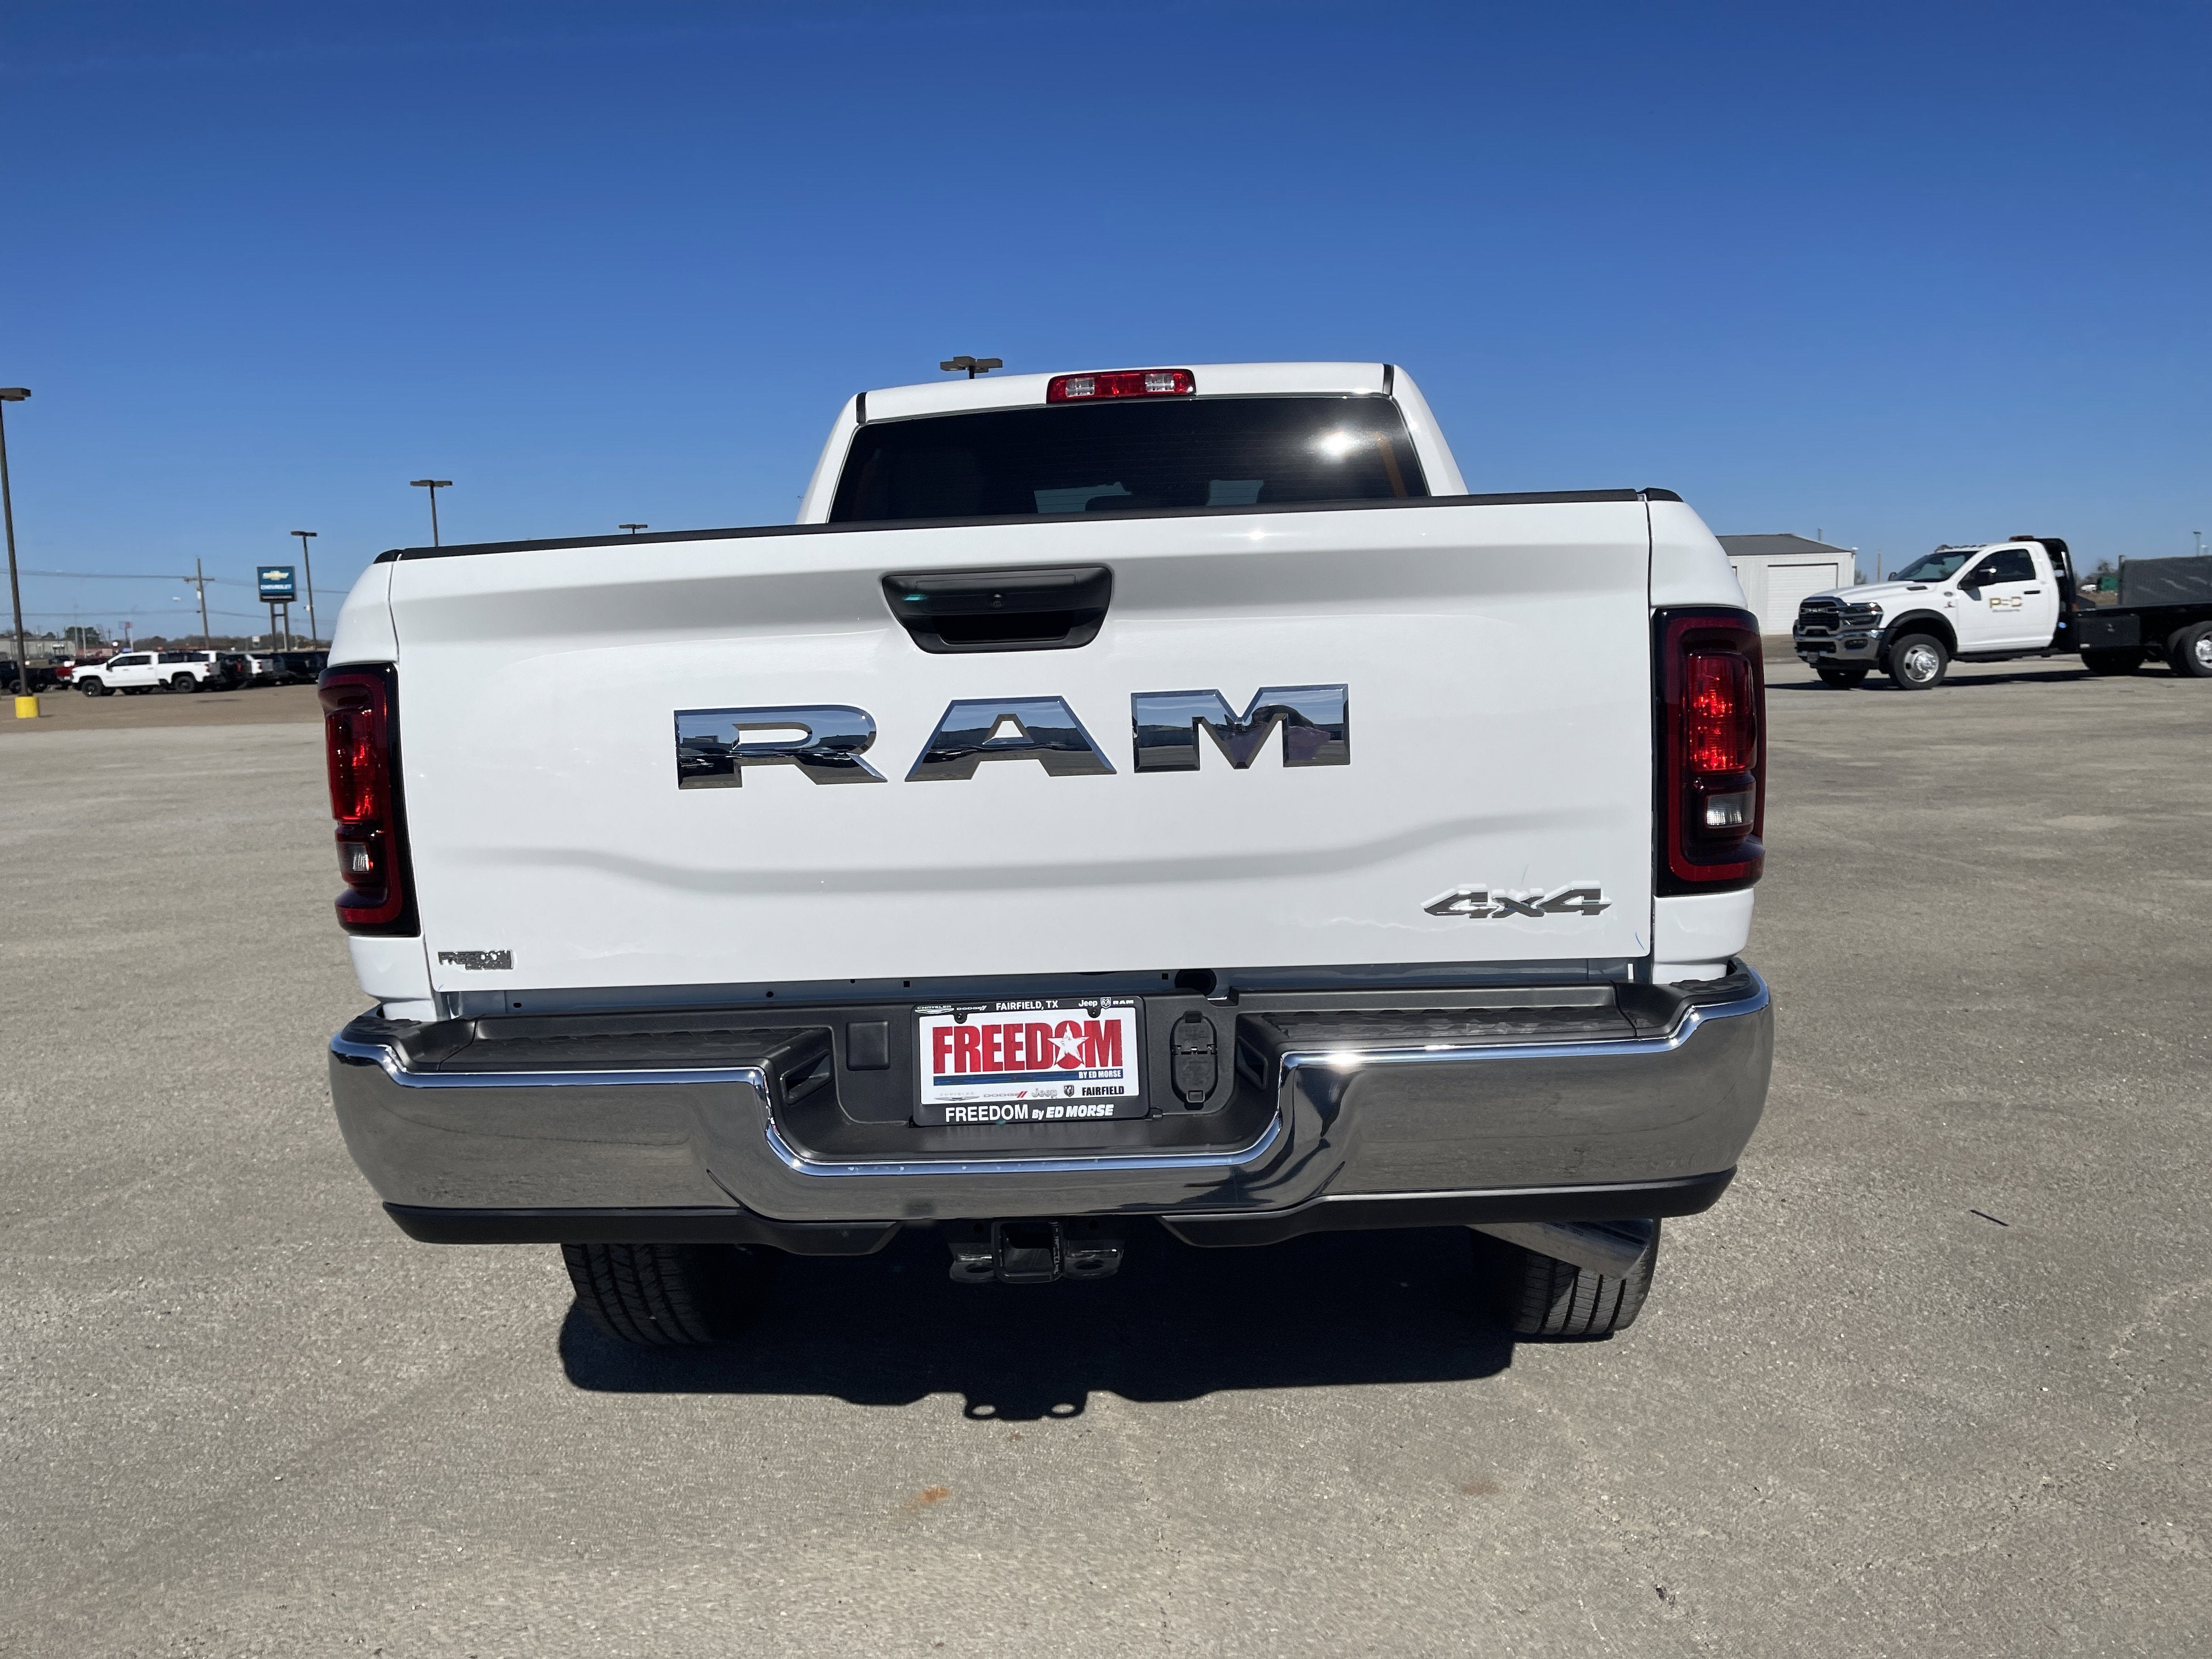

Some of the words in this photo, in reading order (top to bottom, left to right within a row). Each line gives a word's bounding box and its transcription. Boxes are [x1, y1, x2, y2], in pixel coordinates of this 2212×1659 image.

[674, 684, 1350, 789] RAM
[996, 1002, 1045, 1011] FAIRFIELD,
[1045, 1000, 1059, 1009] TX
[933, 1019, 1124, 1074] FREEDOM
[1098, 1070, 1121, 1078] MORSE
[1031, 1088, 1058, 1099] Jeep
[1082, 1086, 1125, 1096] FAIRFIELD
[945, 1104, 1029, 1122] FREEDOM
[1032, 1109, 1045, 1120] By
[1046, 1106, 1064, 1119] ED
[1065, 1104, 1114, 1118] MORSE
